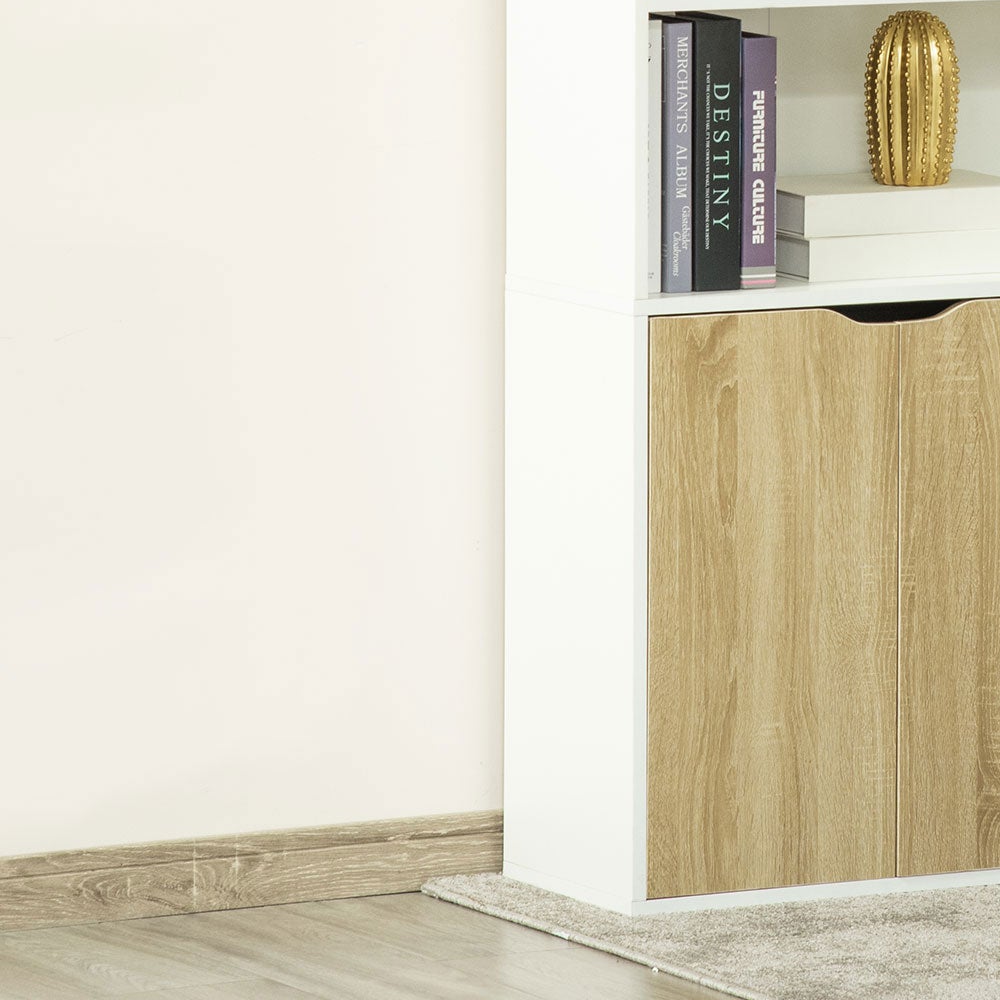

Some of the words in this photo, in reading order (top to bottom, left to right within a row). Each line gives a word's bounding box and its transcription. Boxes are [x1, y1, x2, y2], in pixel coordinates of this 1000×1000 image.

[676, 36, 689, 134] MERCHANTS
[675, 143, 688, 199] ALBUM
[712, 82, 730, 230] DESTINY
[752, 179, 765, 245] CULTURE
[672, 231, 682, 277] Cloakrooms
